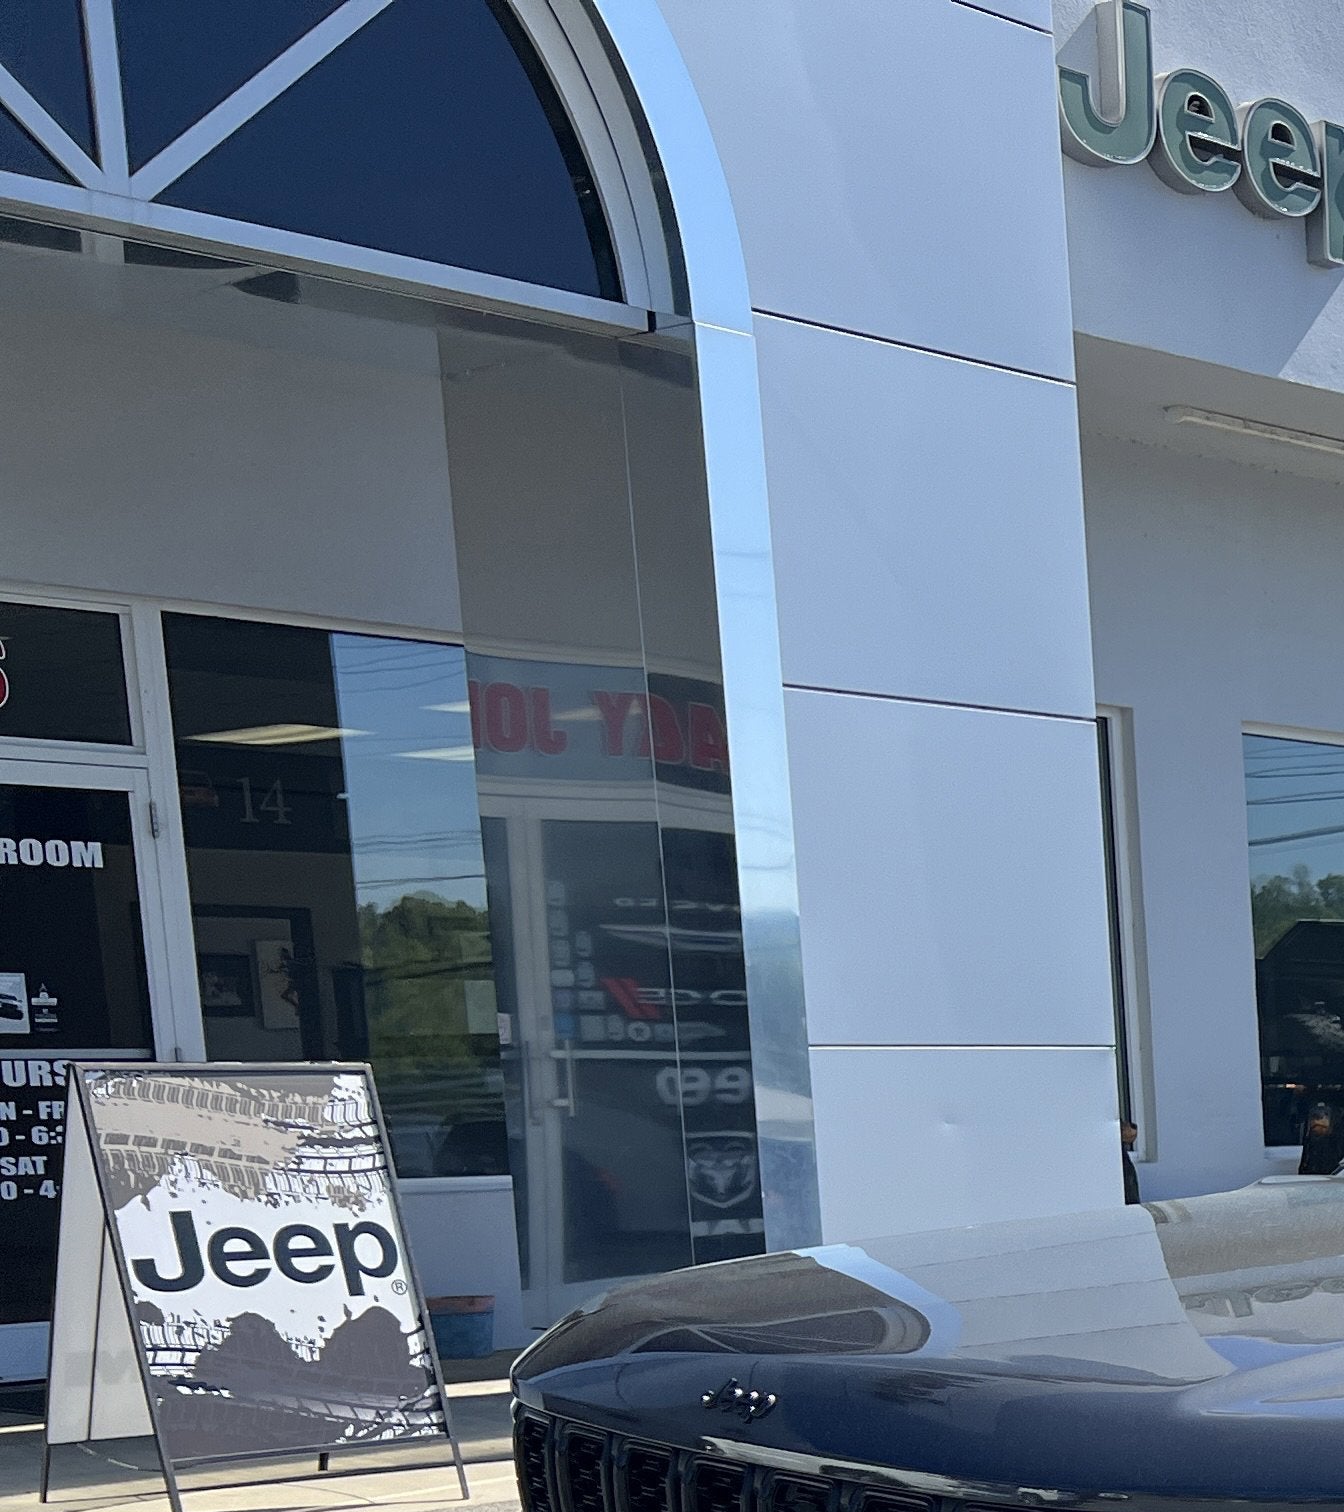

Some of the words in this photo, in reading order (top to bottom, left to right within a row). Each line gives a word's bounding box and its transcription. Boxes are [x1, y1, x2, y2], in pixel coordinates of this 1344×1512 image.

[0, 837, 103, 868] ROOM
[0, 1156, 47, 1175] SAT
[132, 1210, 398, 1297] Jeep
